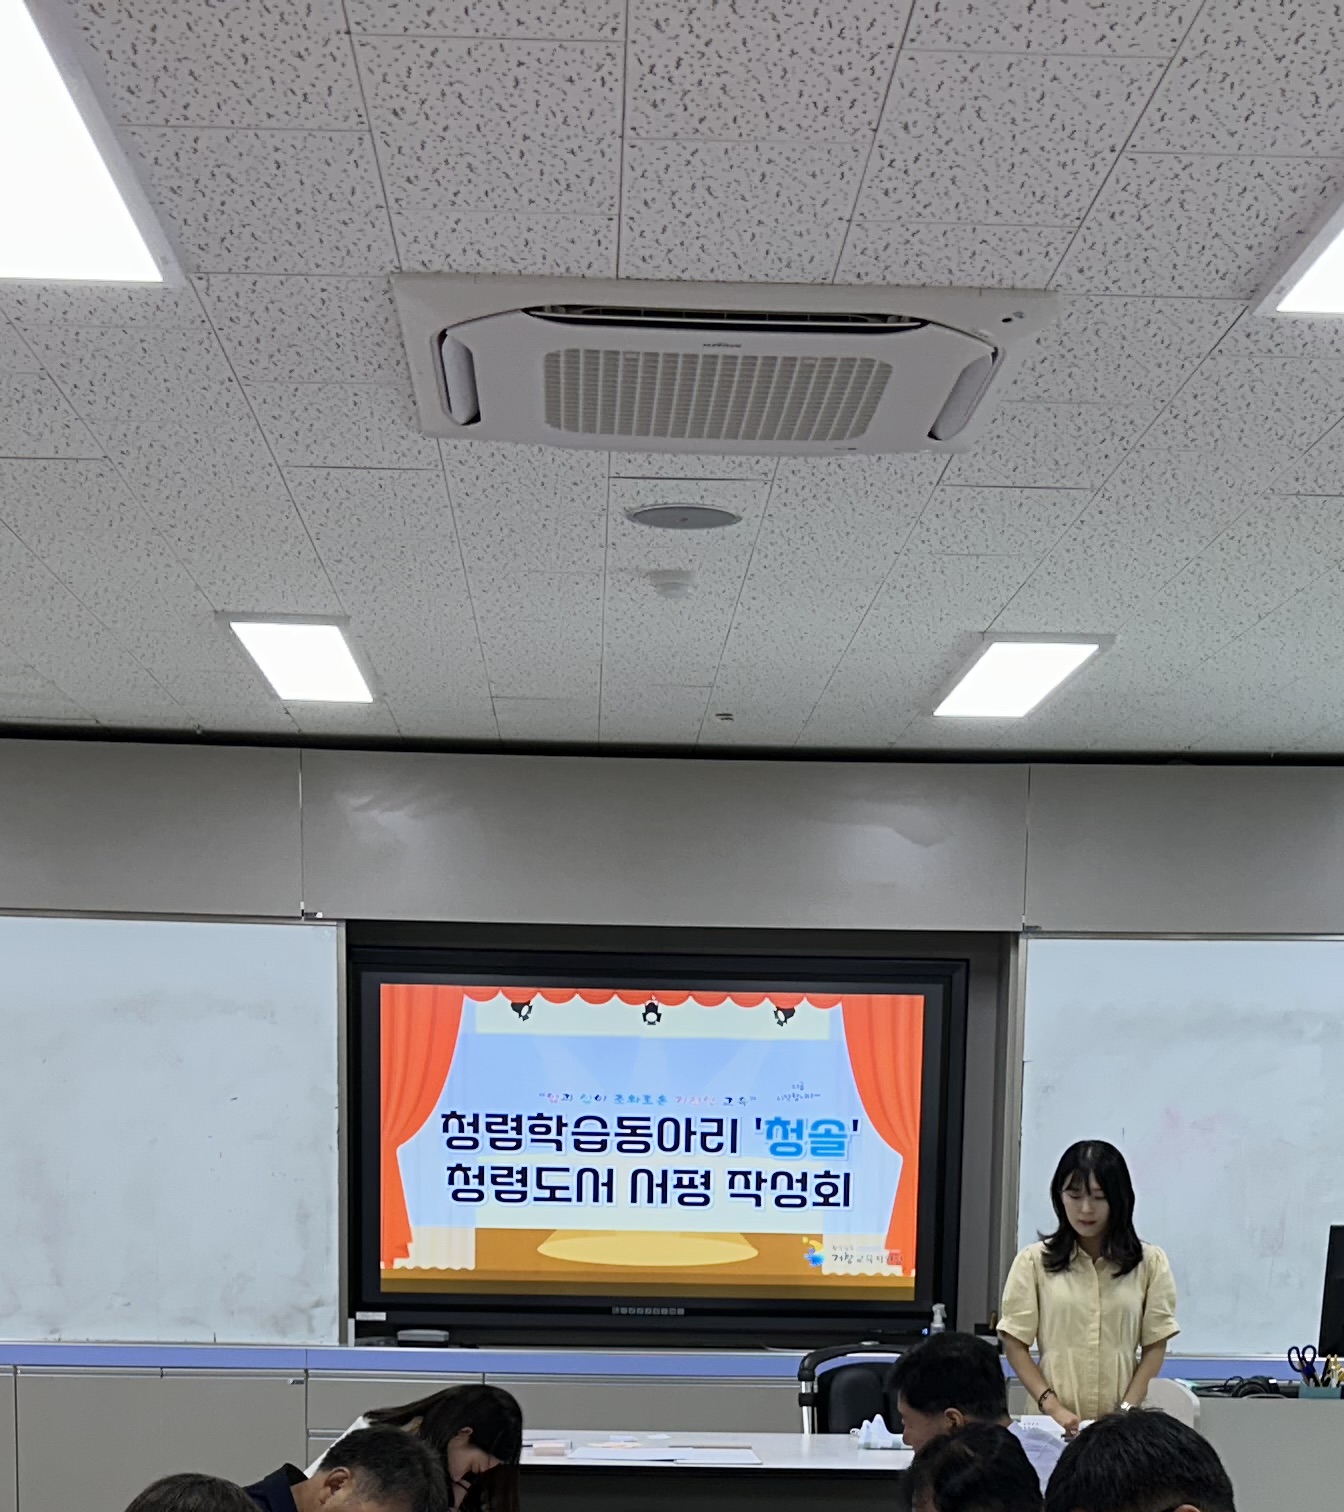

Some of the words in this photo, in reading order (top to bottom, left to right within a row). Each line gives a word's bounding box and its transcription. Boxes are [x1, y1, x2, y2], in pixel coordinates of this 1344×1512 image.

[441, 1111, 738, 1154] 청렴학습동아리
[447, 1164, 613, 1203] 청렴도서
[631, 1168, 711, 1207] 서평
[727, 1170, 851, 1208] 작성회
